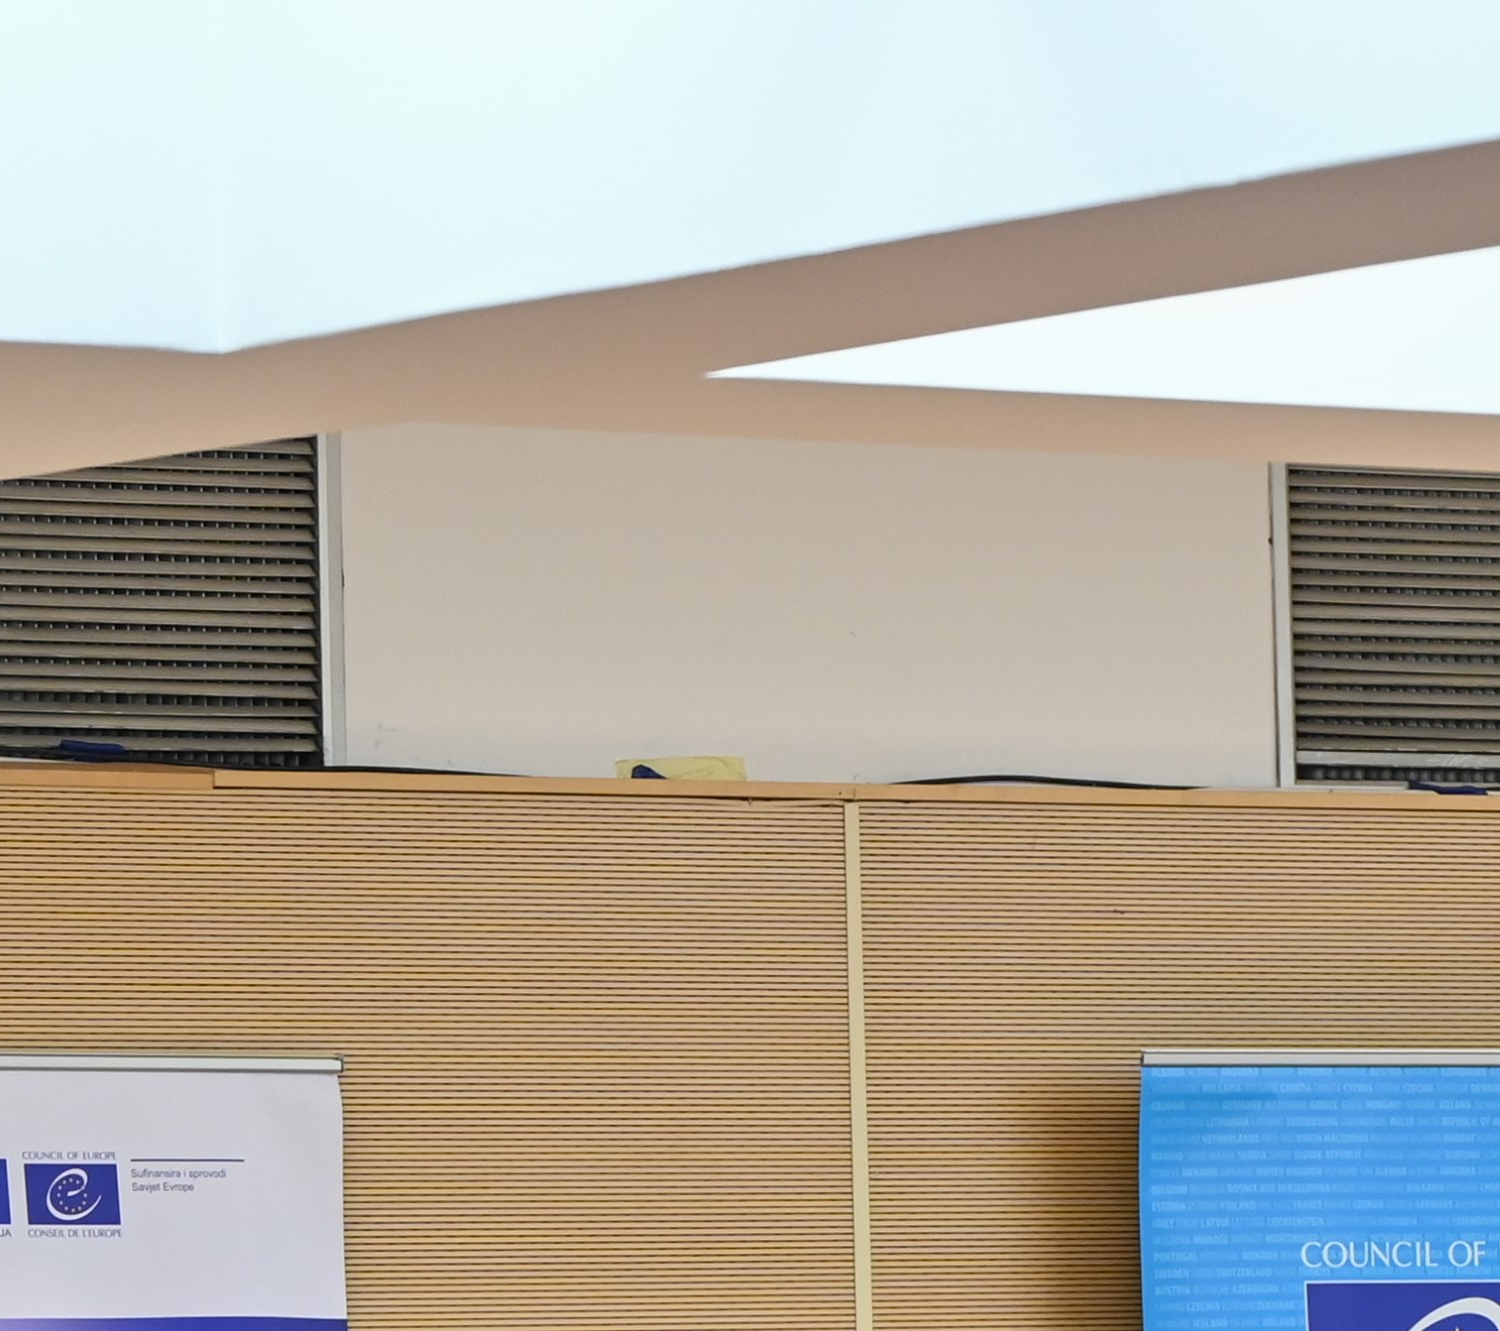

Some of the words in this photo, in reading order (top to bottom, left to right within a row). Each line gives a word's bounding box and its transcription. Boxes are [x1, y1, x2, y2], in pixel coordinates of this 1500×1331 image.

[22, 1152, 64, 1160] COUNCIL
[67, 1152, 79, 1160] OF
[82, 1152, 116, 1160] EUROPE
[131, 1169, 180, 1178] Sufinansira
[183, 1169, 186, 1177] i
[189, 1169, 226, 1179] sprovodi
[132, 1182, 160, 1192] Savjet
[163, 1183, 194, 1192] Evrope
[28, 1229, 64, 1238] CONSEIL
[68, 1229, 79, 1238] DE
[1301, 1240, 1438, 1268] COUNCIL
[1448, 1241, 1486, 1267] OF
